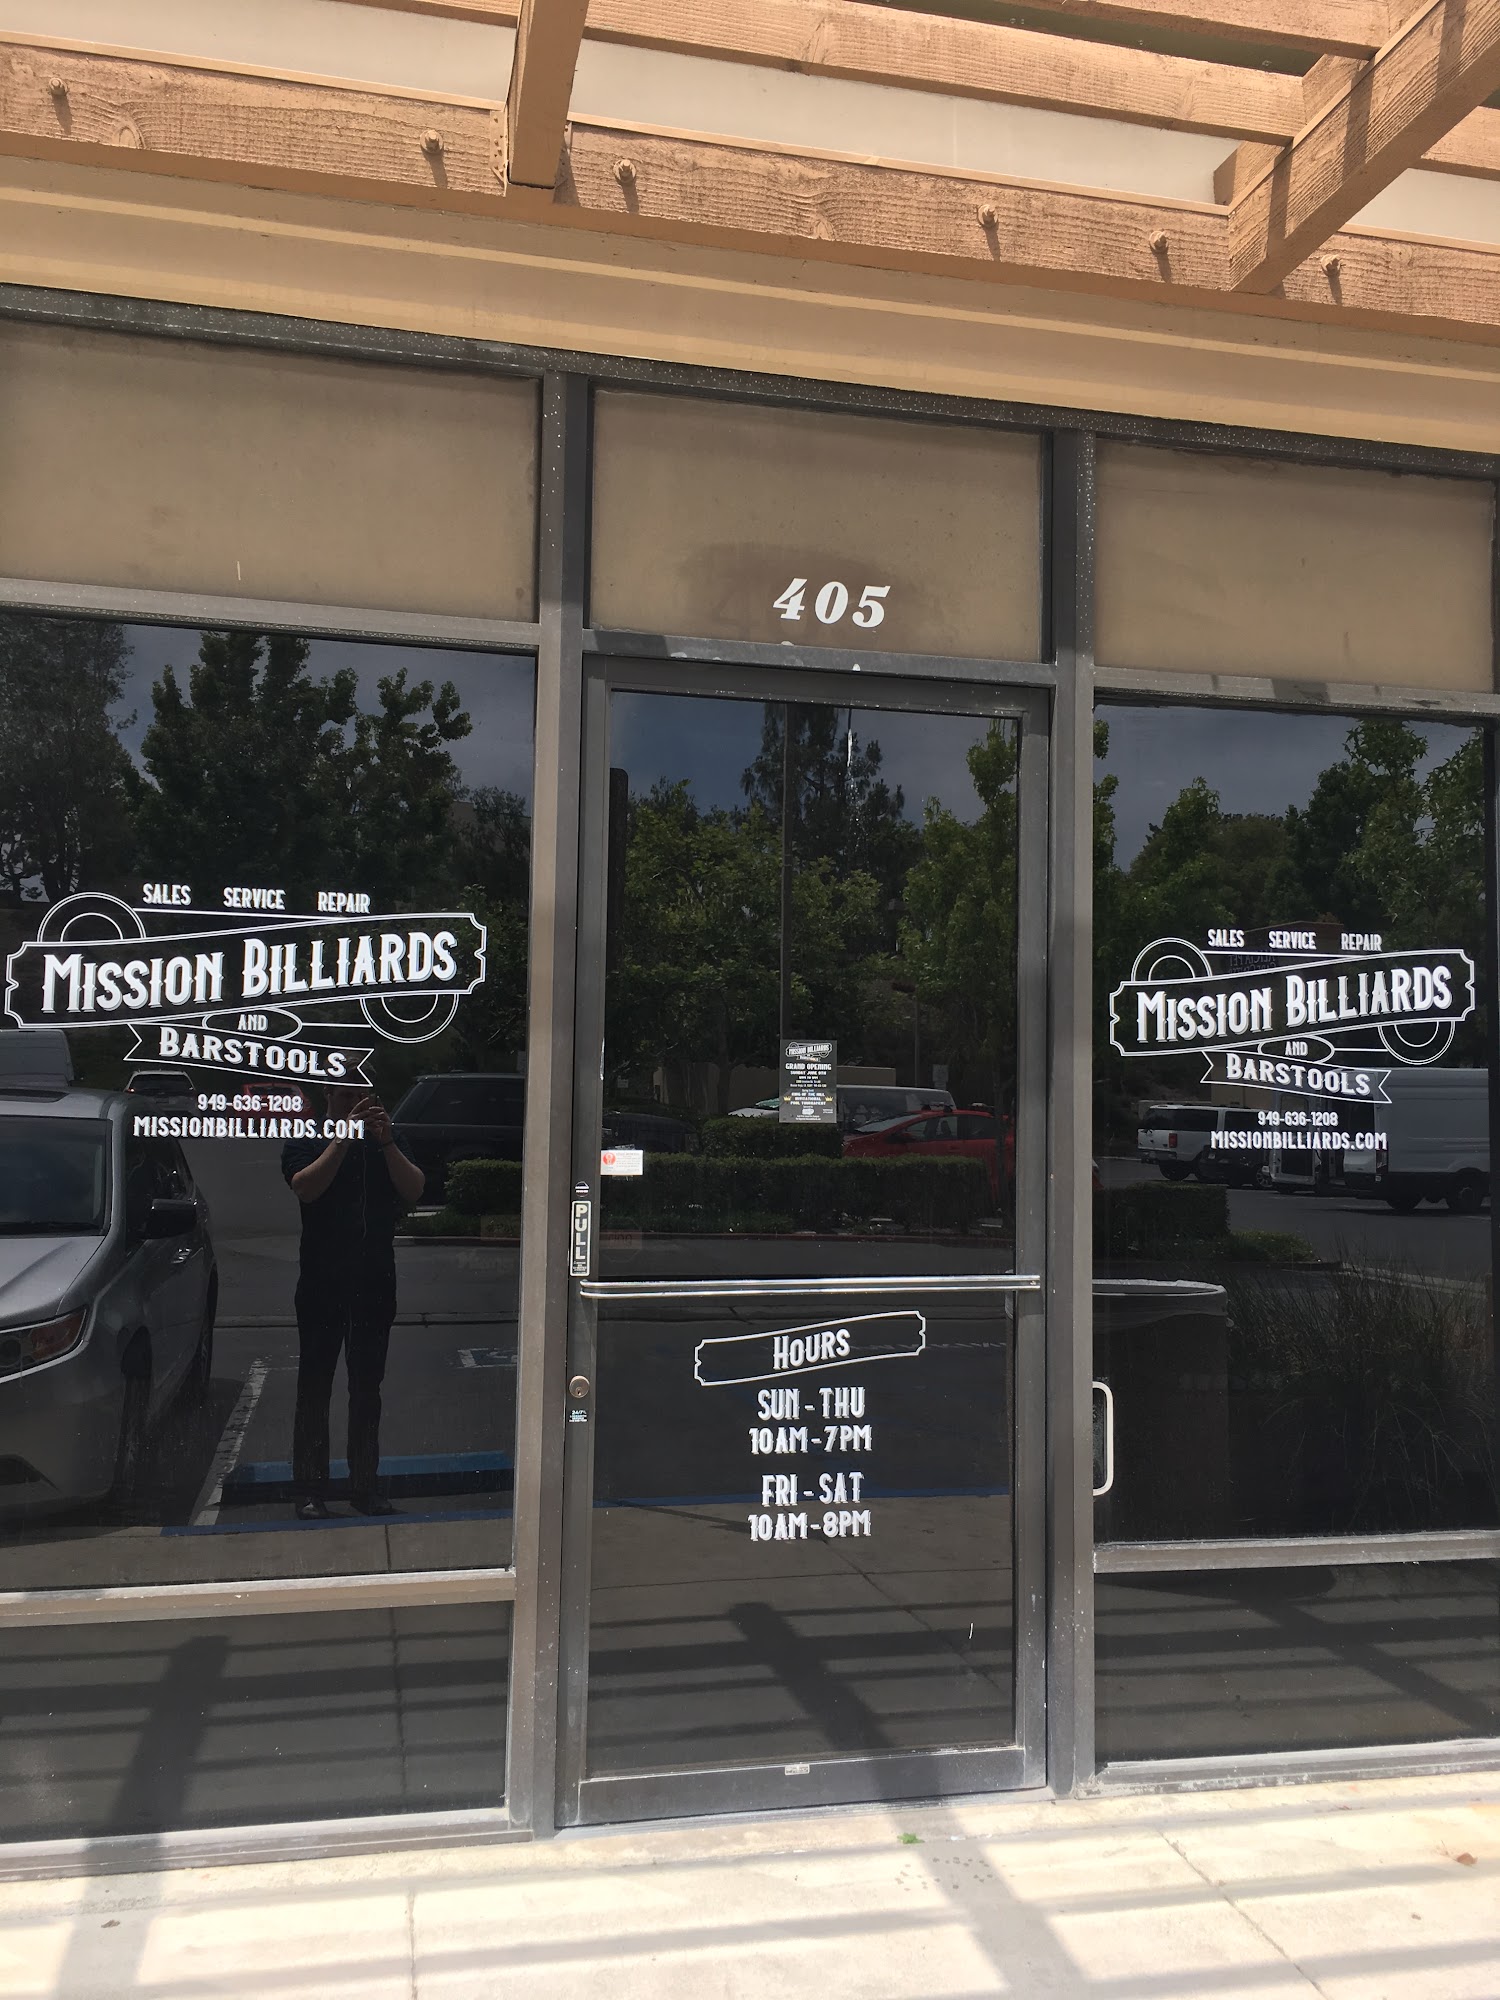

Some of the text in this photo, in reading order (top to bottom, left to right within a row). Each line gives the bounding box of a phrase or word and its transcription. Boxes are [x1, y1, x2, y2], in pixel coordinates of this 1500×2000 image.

[773, 578, 891, 628] 405
[142, 883, 370, 914] SALES SERVICE REPAIR
[1207, 928, 1382, 952] SALES SERVICE REPAIR
[42, 930, 458, 1014] MISSION BILLIARDS
[1136, 965, 1452, 1043] MISSION BILLIARDS
[237, 1014, 268, 1032] AND
[159, 1026, 348, 1079] BARSTOOLS
[1285, 1041, 1308, 1057] AND
[1226, 1053, 1372, 1096] BARSTOOLS
[197, 1093, 303, 1113] 949-636-1208
[1257, 1110, 1339, 1127] 949-636-1208
[133, 1115, 365, 1140] MISSIONBILLIARDS.COM
[1210, 1130, 1388, 1151] MISSIONBILLIARDS.COM
[574, 1204, 588, 1260] PULL
[773, 1328, 850, 1370] HOURS
[757, 1388, 800, 1420] SUN
[819, 1387, 865, 1419] THU
[761, 1474, 798, 1508] FRI
[819, 1471, 865, 1505] SAT
